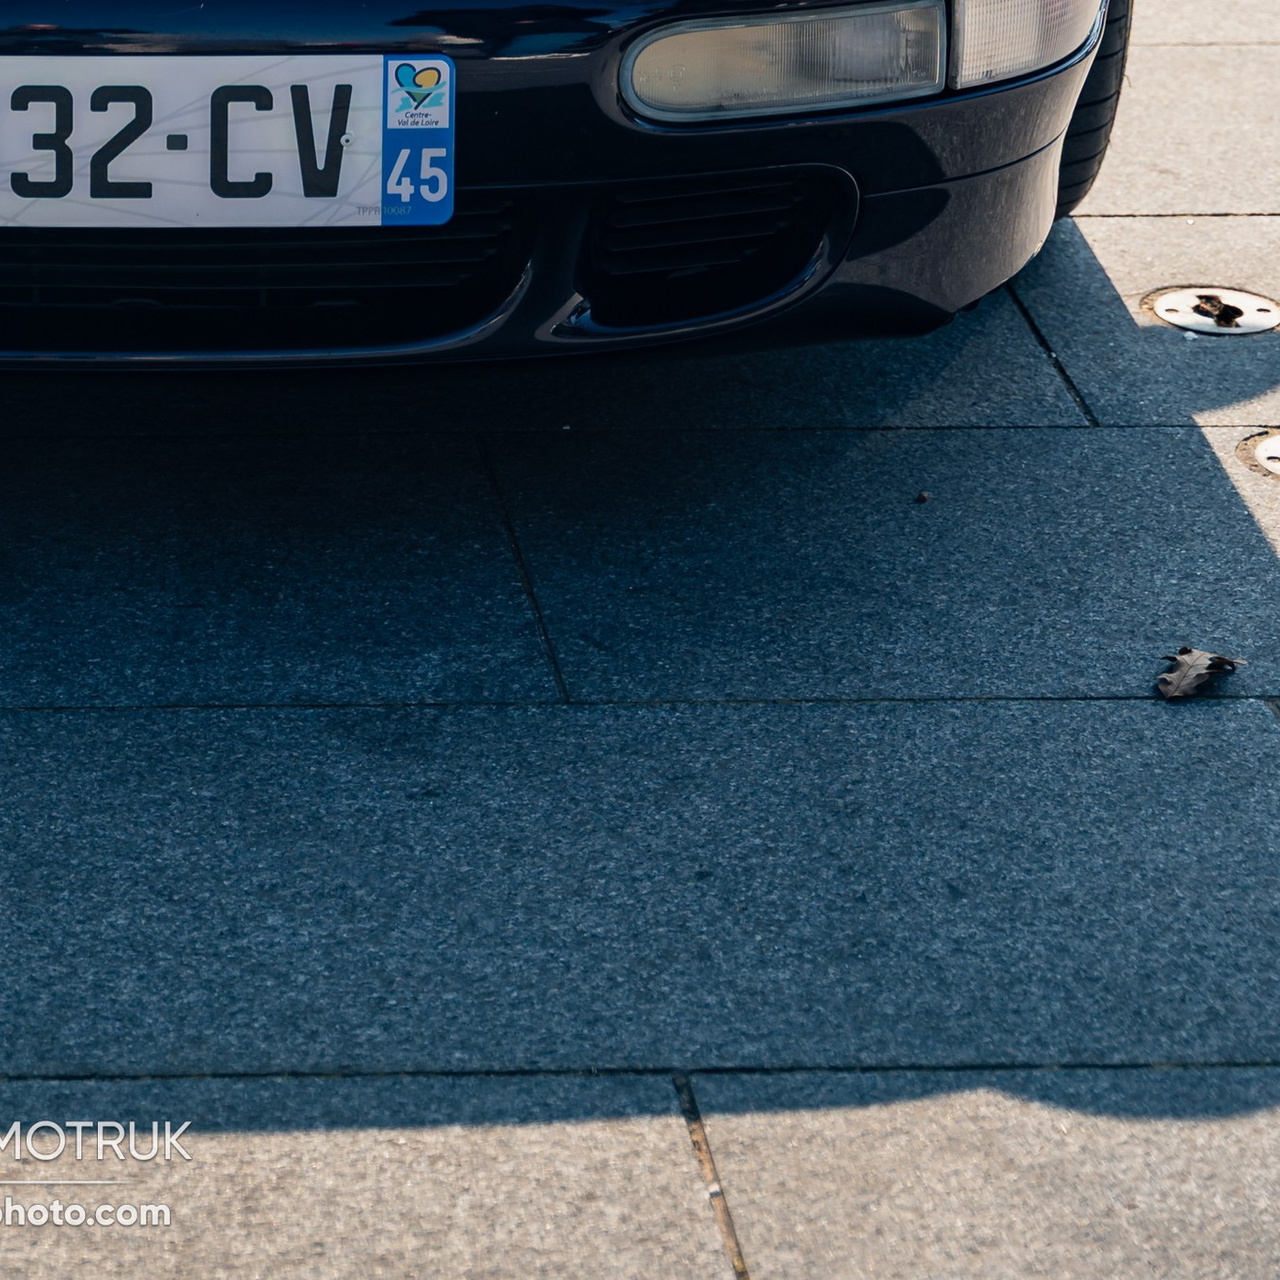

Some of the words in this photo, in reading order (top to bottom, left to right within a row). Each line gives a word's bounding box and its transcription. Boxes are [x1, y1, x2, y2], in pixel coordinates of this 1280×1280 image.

[404, 111, 432, 119] Centre-
[410, 119, 420, 127] de
[420, 119, 439, 127] Loire
[386, 148, 448, 203] 45
